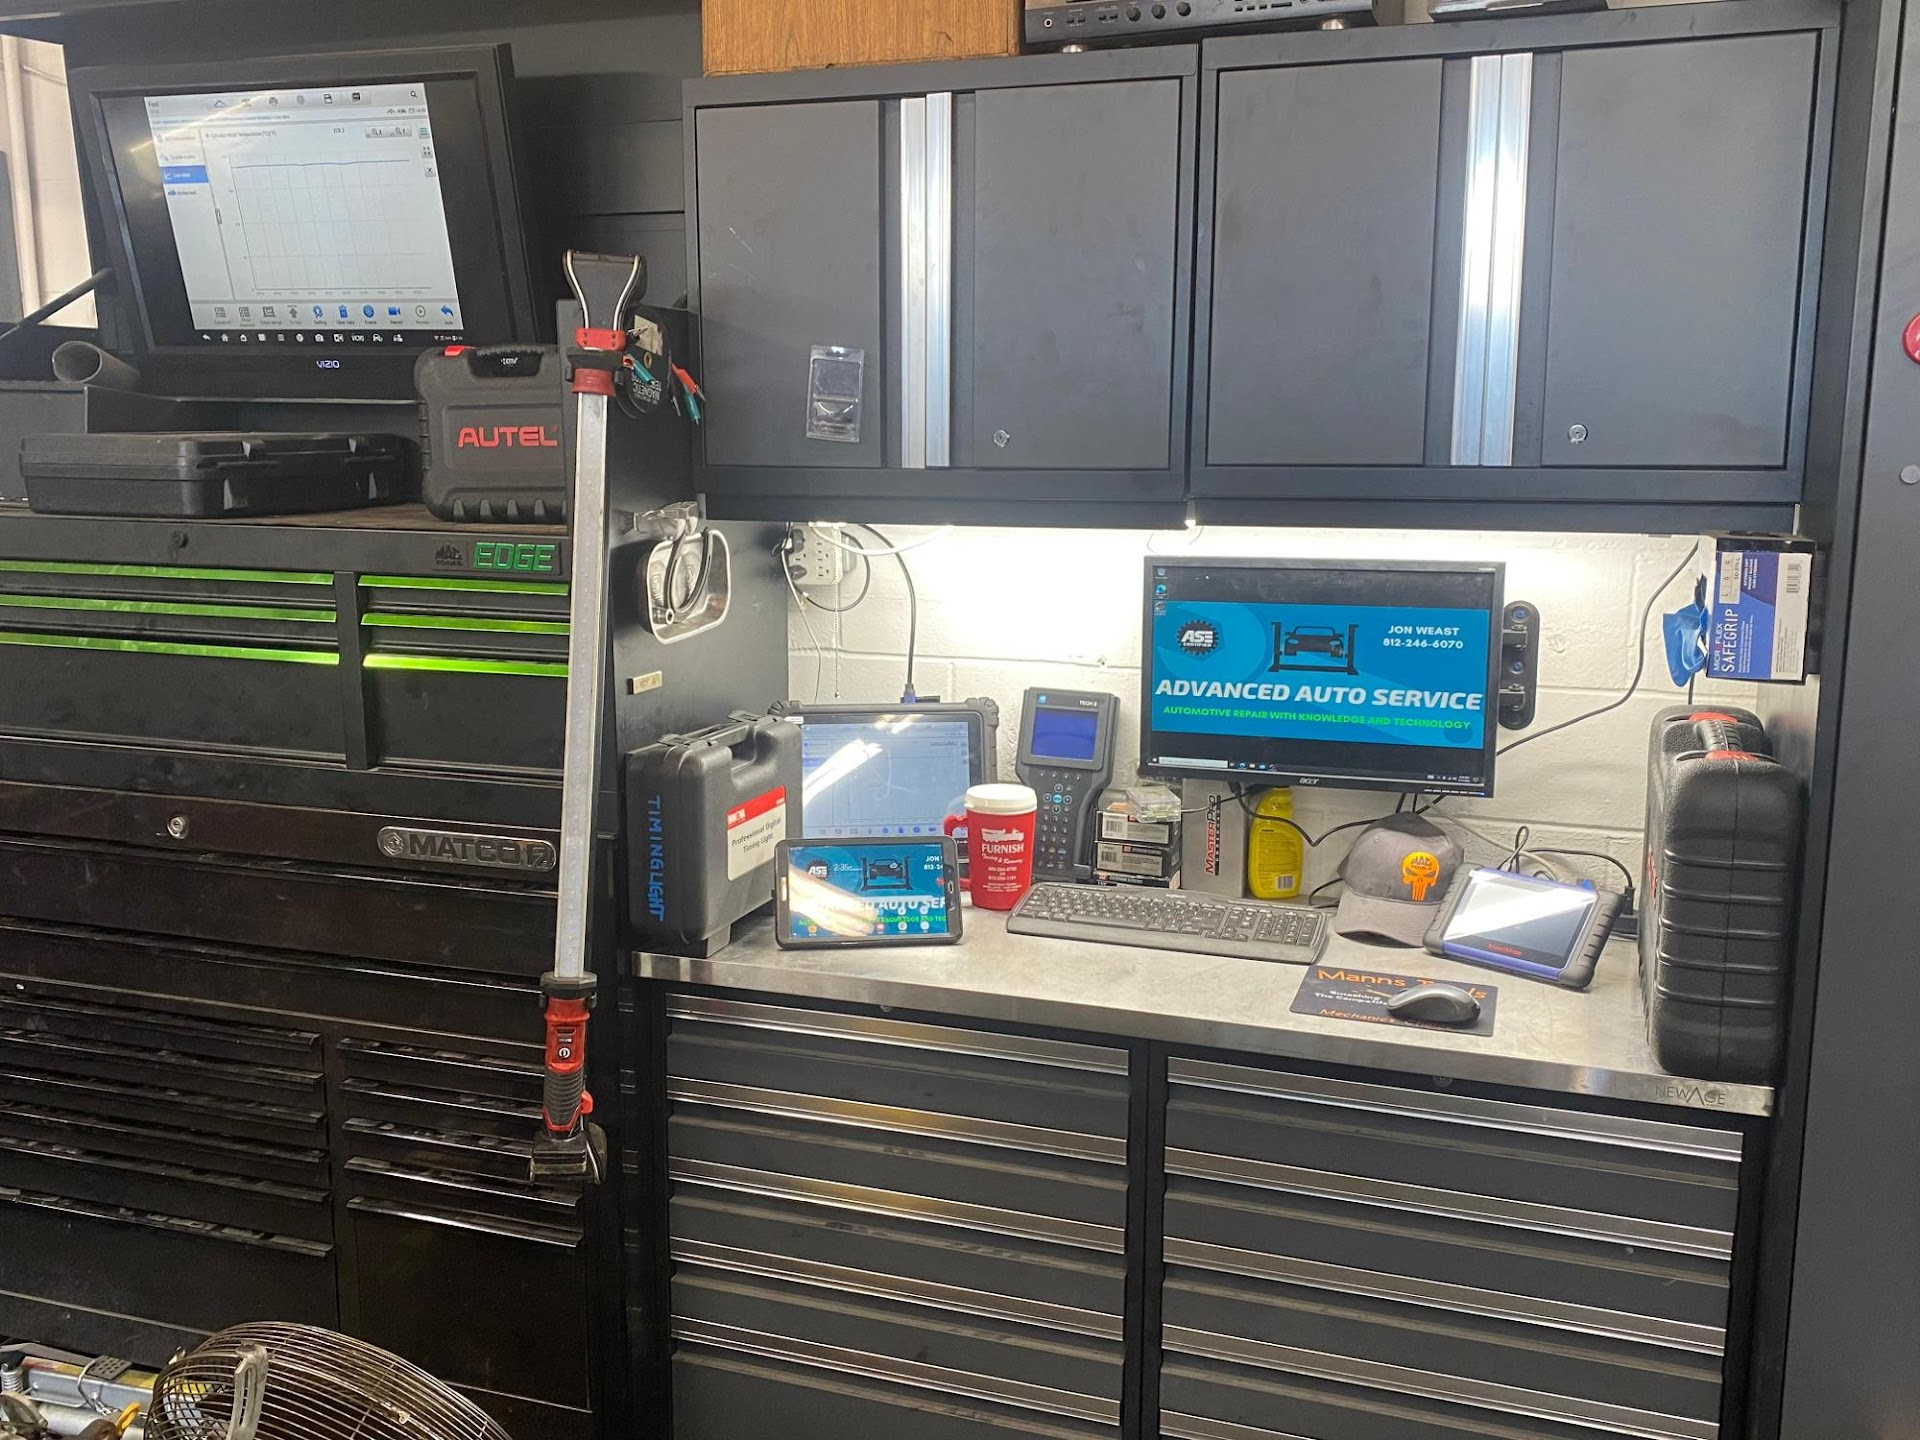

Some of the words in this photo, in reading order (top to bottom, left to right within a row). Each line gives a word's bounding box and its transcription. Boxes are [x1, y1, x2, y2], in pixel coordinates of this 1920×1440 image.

[316, 360, 340, 369] VIZIO
[458, 425, 558, 448] AUTEL
[473, 541, 555, 571] EDGE
[1181, 630, 1214, 644] ASE
[1388, 625, 1412, 635] JON
[1416, 626, 1460, 636] WEAST
[1383, 638, 1464, 649] 812-246-6070
[1722, 608, 1739, 673] SAFEGRIP
[1155, 679, 1290, 701] ADVANCED
[1294, 686, 1367, 705] AUTO
[1371, 689, 1483, 711] SERVICE
[1163, 706, 1231, 718] AUTOMOTIVE
[1233, 710, 1268, 720] REPAIR
[1270, 712, 1297, 721] WITH
[1299, 713, 1365, 725] KNOWLEDGE
[1368, 716, 1390, 726] AND
[1394, 717, 1471, 730] TECHNOLOGY
[731, 825, 765, 847] Professional
[409, 833, 521, 864] MATCO
[981, 843, 1024, 854] FURNISH
[1317, 969, 1406, 987] Manns
[1329, 990, 1380, 1000] Smashing
[1320, 1008, 1396, 1023] Mechanics
[1655, 1086, 1726, 1106] NEWAGE
